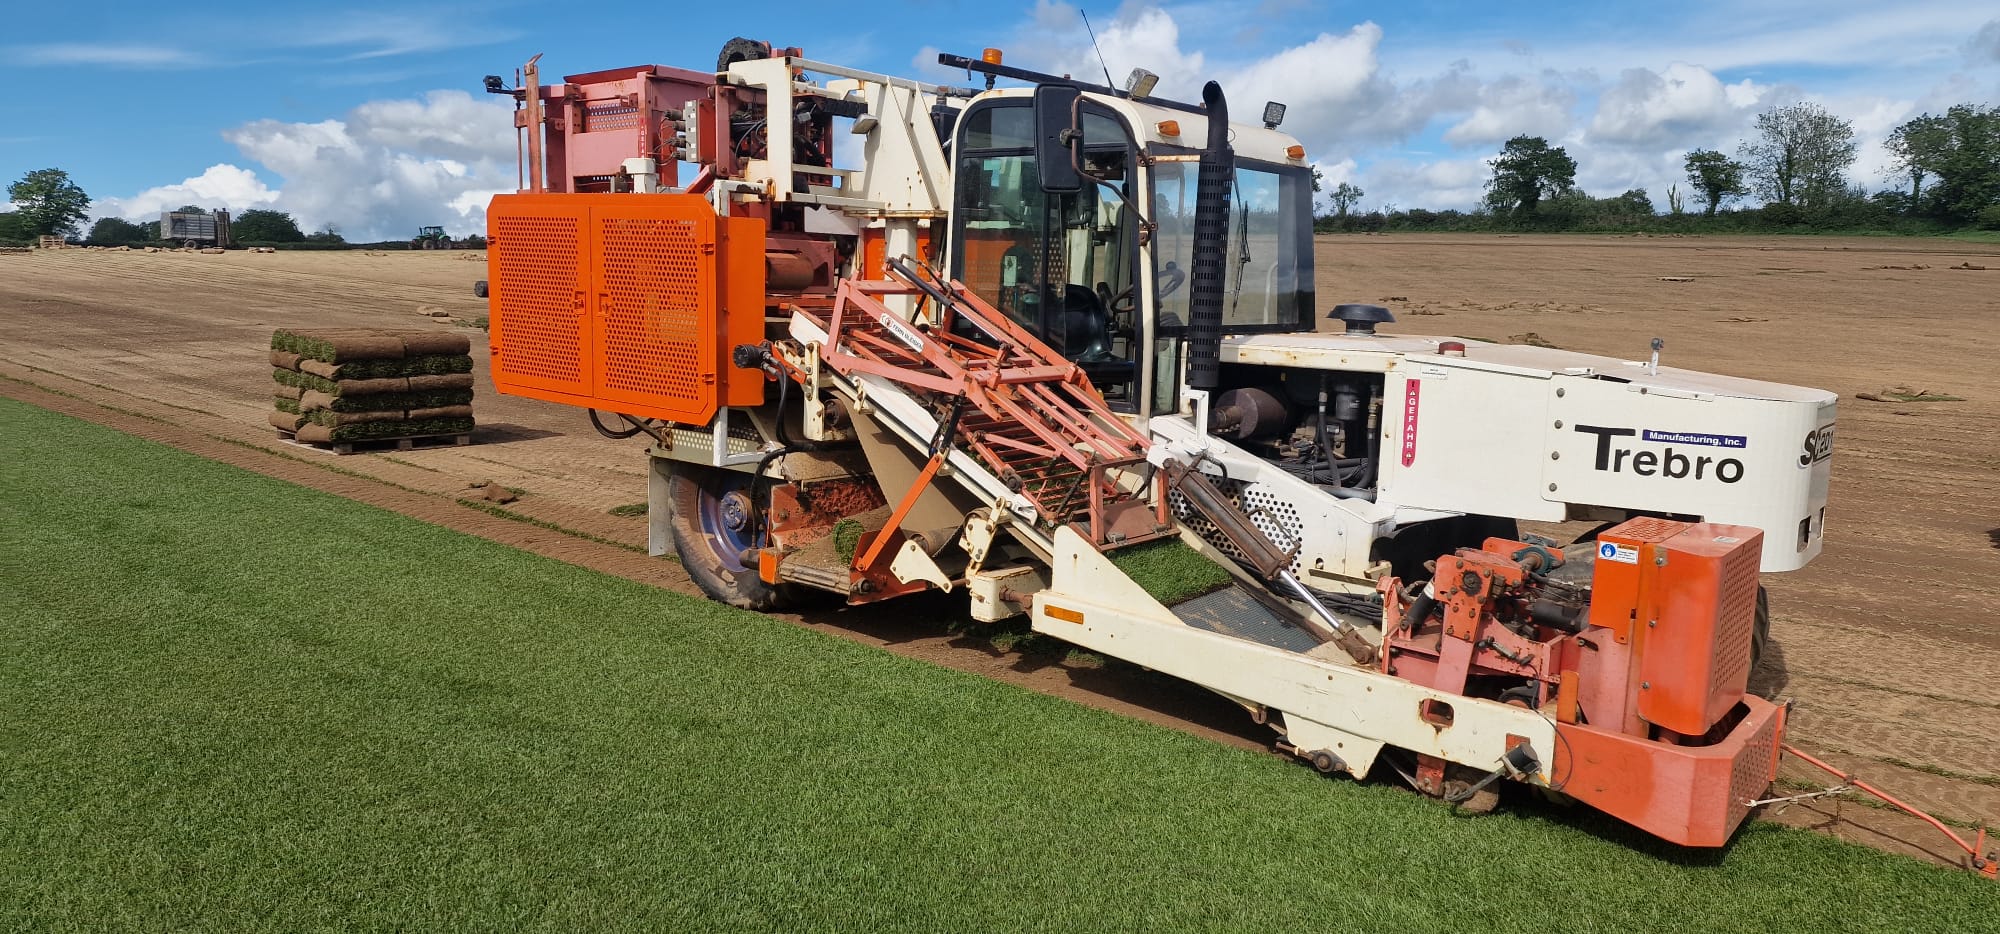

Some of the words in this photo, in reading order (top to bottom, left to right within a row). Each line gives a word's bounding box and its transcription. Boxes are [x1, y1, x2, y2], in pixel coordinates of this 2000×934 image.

[1406, 397, 1417, 449] GEFAHR
[1649, 431, 1722, 446] Manufacturing,
[1724, 437, 1743, 447] Inc.
[1574, 424, 1745, 484] Trebro
